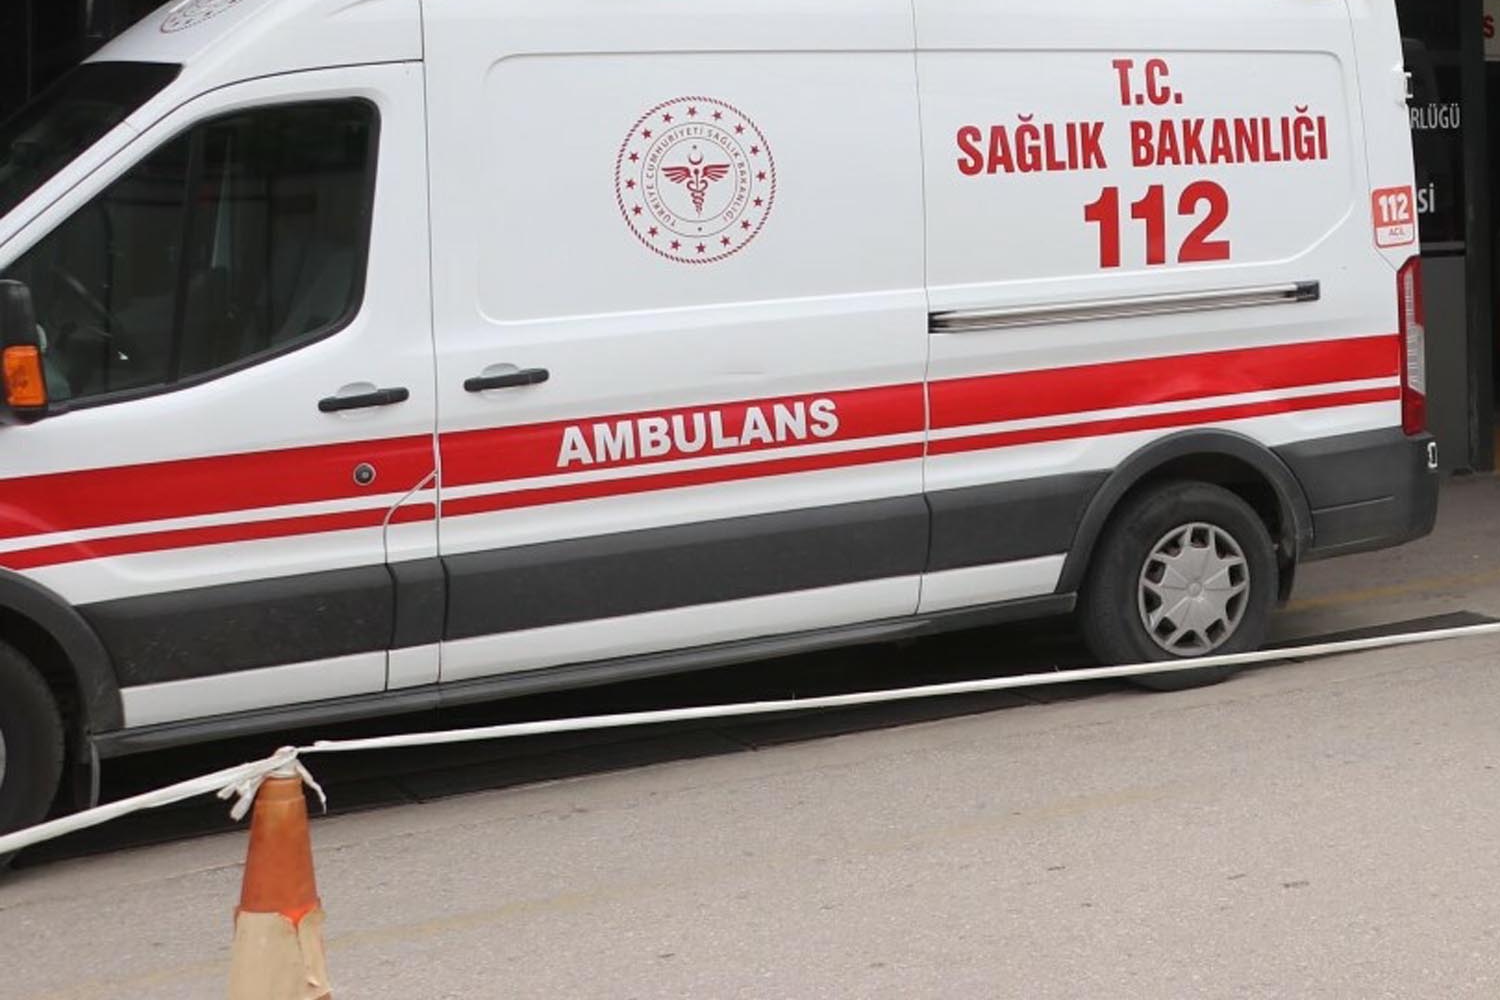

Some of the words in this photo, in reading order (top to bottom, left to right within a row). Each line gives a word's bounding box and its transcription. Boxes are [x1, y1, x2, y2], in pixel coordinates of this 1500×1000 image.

[1113, 59, 1183, 106] T.C.
[956, 114, 1107, 176] SAĞLIK
[1131, 105, 1328, 168] BAKANLIĞI
[1084, 180, 1230, 269] 112
[1379, 193, 1410, 222] 112
[557, 399, 840, 467] AMBULANS
